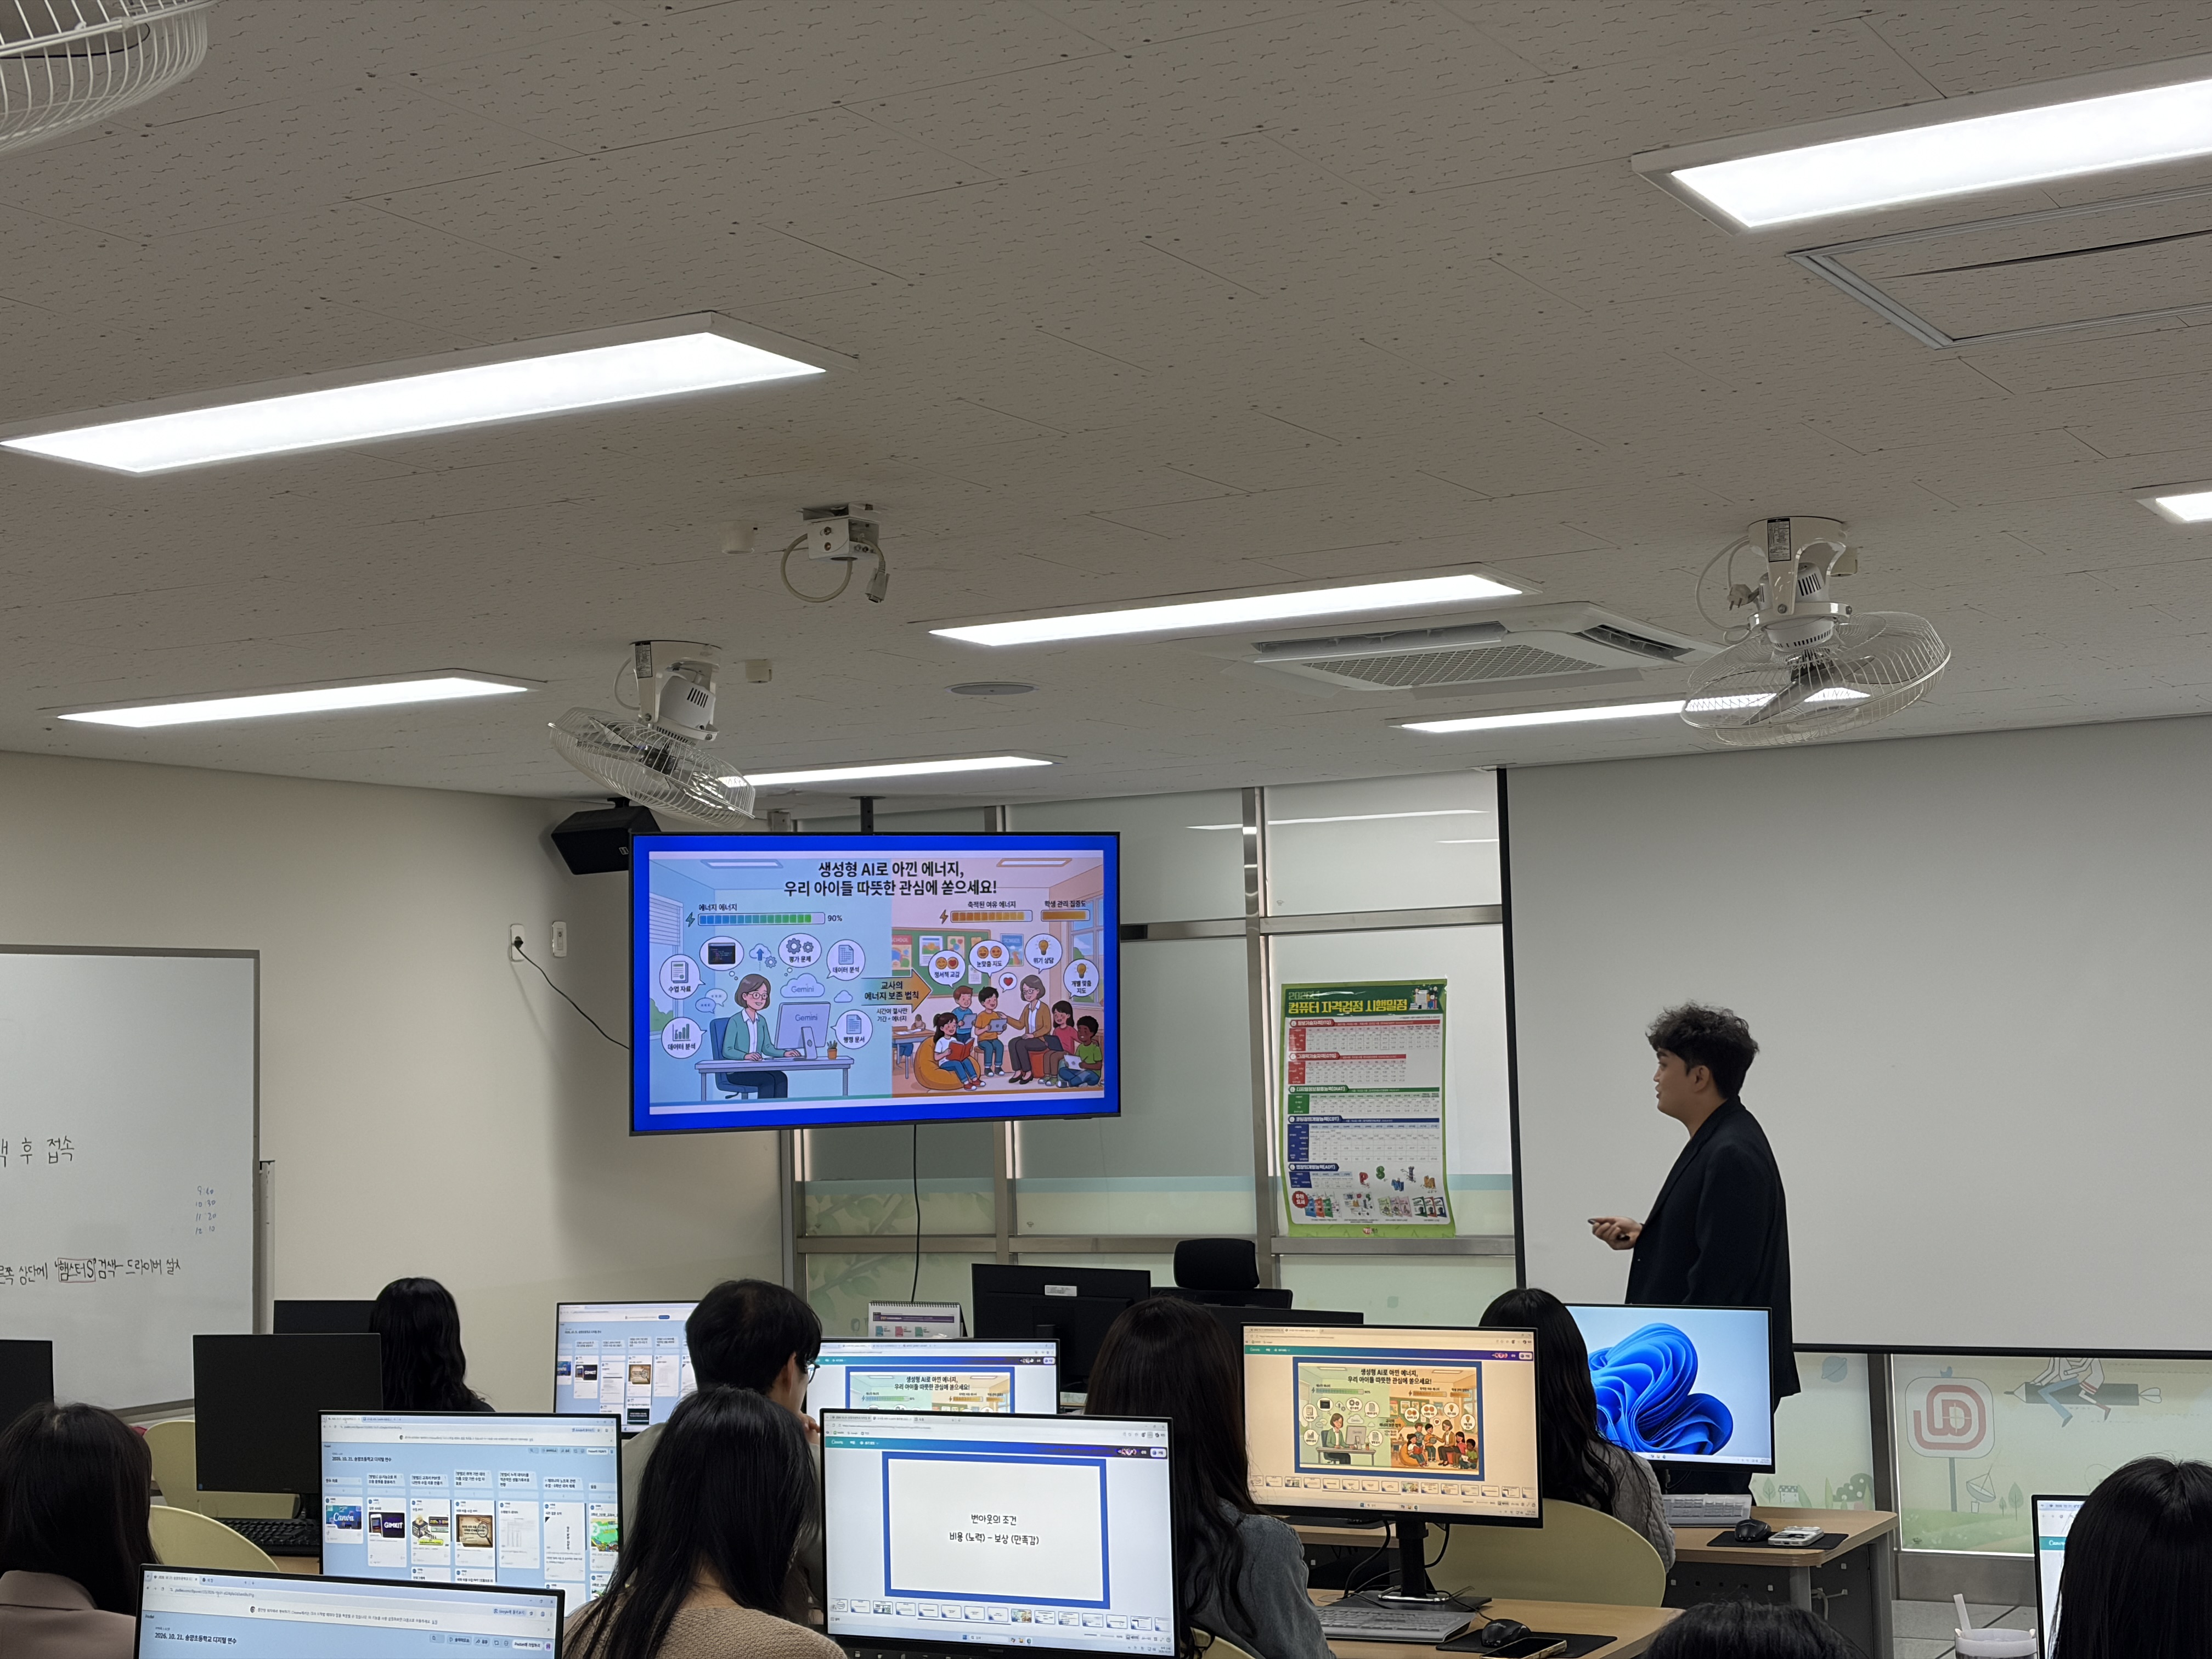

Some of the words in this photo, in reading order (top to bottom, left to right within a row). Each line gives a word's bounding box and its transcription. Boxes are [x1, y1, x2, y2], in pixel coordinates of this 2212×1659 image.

[819, 862, 857, 877] 생성형
[862, 862, 889, 877] AI로
[892, 861, 917, 877] 아낀
[921, 861, 964, 878] 에너지,
[784, 881, 810, 896] 우리
[814, 880, 853, 896] 아이들
[857, 880, 895, 896] 따뜻한
[899, 879, 938, 895] 관심에
[941, 879, 997, 895] 쏟으세요!
[791, 985, 815, 994] Gemini
[881, 980, 903, 990] 교사의
[864, 991, 887, 1001] 에너지
[888, 991, 903, 1000] 보존
[905, 991, 919, 1000] 법칙
[1289, 1001, 1319, 1014] 컴퓨터
[1321, 1000, 1364, 1013] 자격검정
[1365, 999, 1407, 1012] 시행일정
[794, 1013, 819, 1022] Gemini
[20, 1137, 33, 1164] 후
[47, 1135, 75, 1164] 접속
[19, 1263, 48, 1285] 상단에
[126, 1259, 162, 1275] 드라이버
[1361, 1368, 1376, 1376] 생성형
[333, 1512, 354, 1522] Canva
[971, 1514, 1001, 1525] 번아웃의
[1002, 1515, 1017, 1526] 조건
[949, 1532, 963, 1543] 비용
[966, 1532, 985, 1543] (노력)
[995, 1534, 1009, 1544] 보상
[1011, 1534, 1040, 1546] (만족감)
